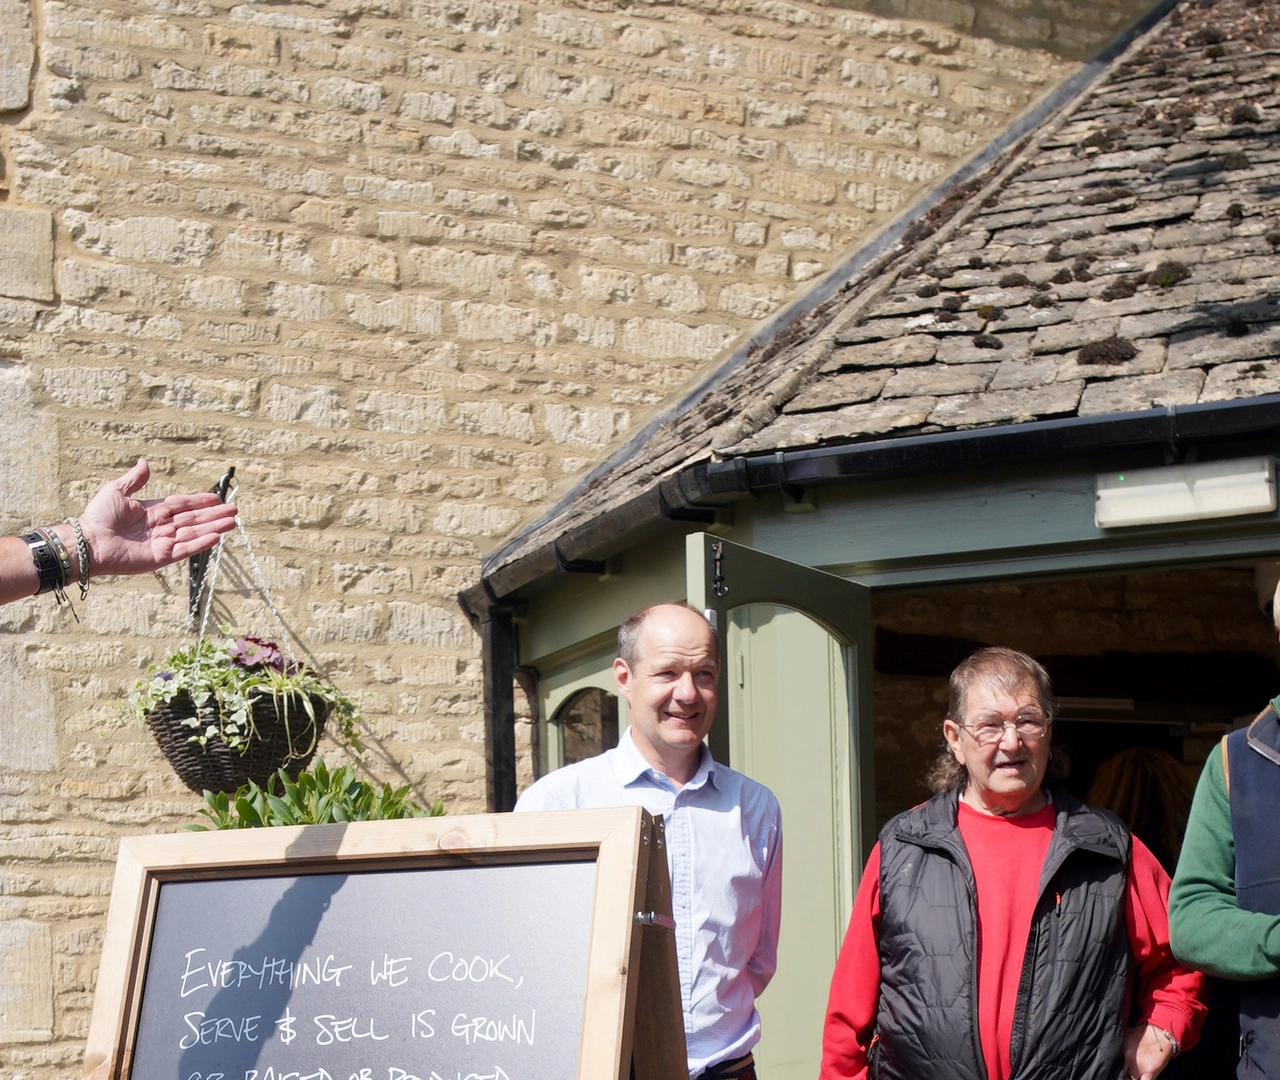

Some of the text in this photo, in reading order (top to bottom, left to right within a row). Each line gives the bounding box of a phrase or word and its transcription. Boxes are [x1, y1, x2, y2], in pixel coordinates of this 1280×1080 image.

[180, 947, 524, 998] EVERYTHING WE COOK,
[178, 1011, 262, 1050] SERVE
[313, 1014, 390, 1046] SELL
[411, 1008, 436, 1039] IS
[451, 1009, 536, 1046] GROWN
